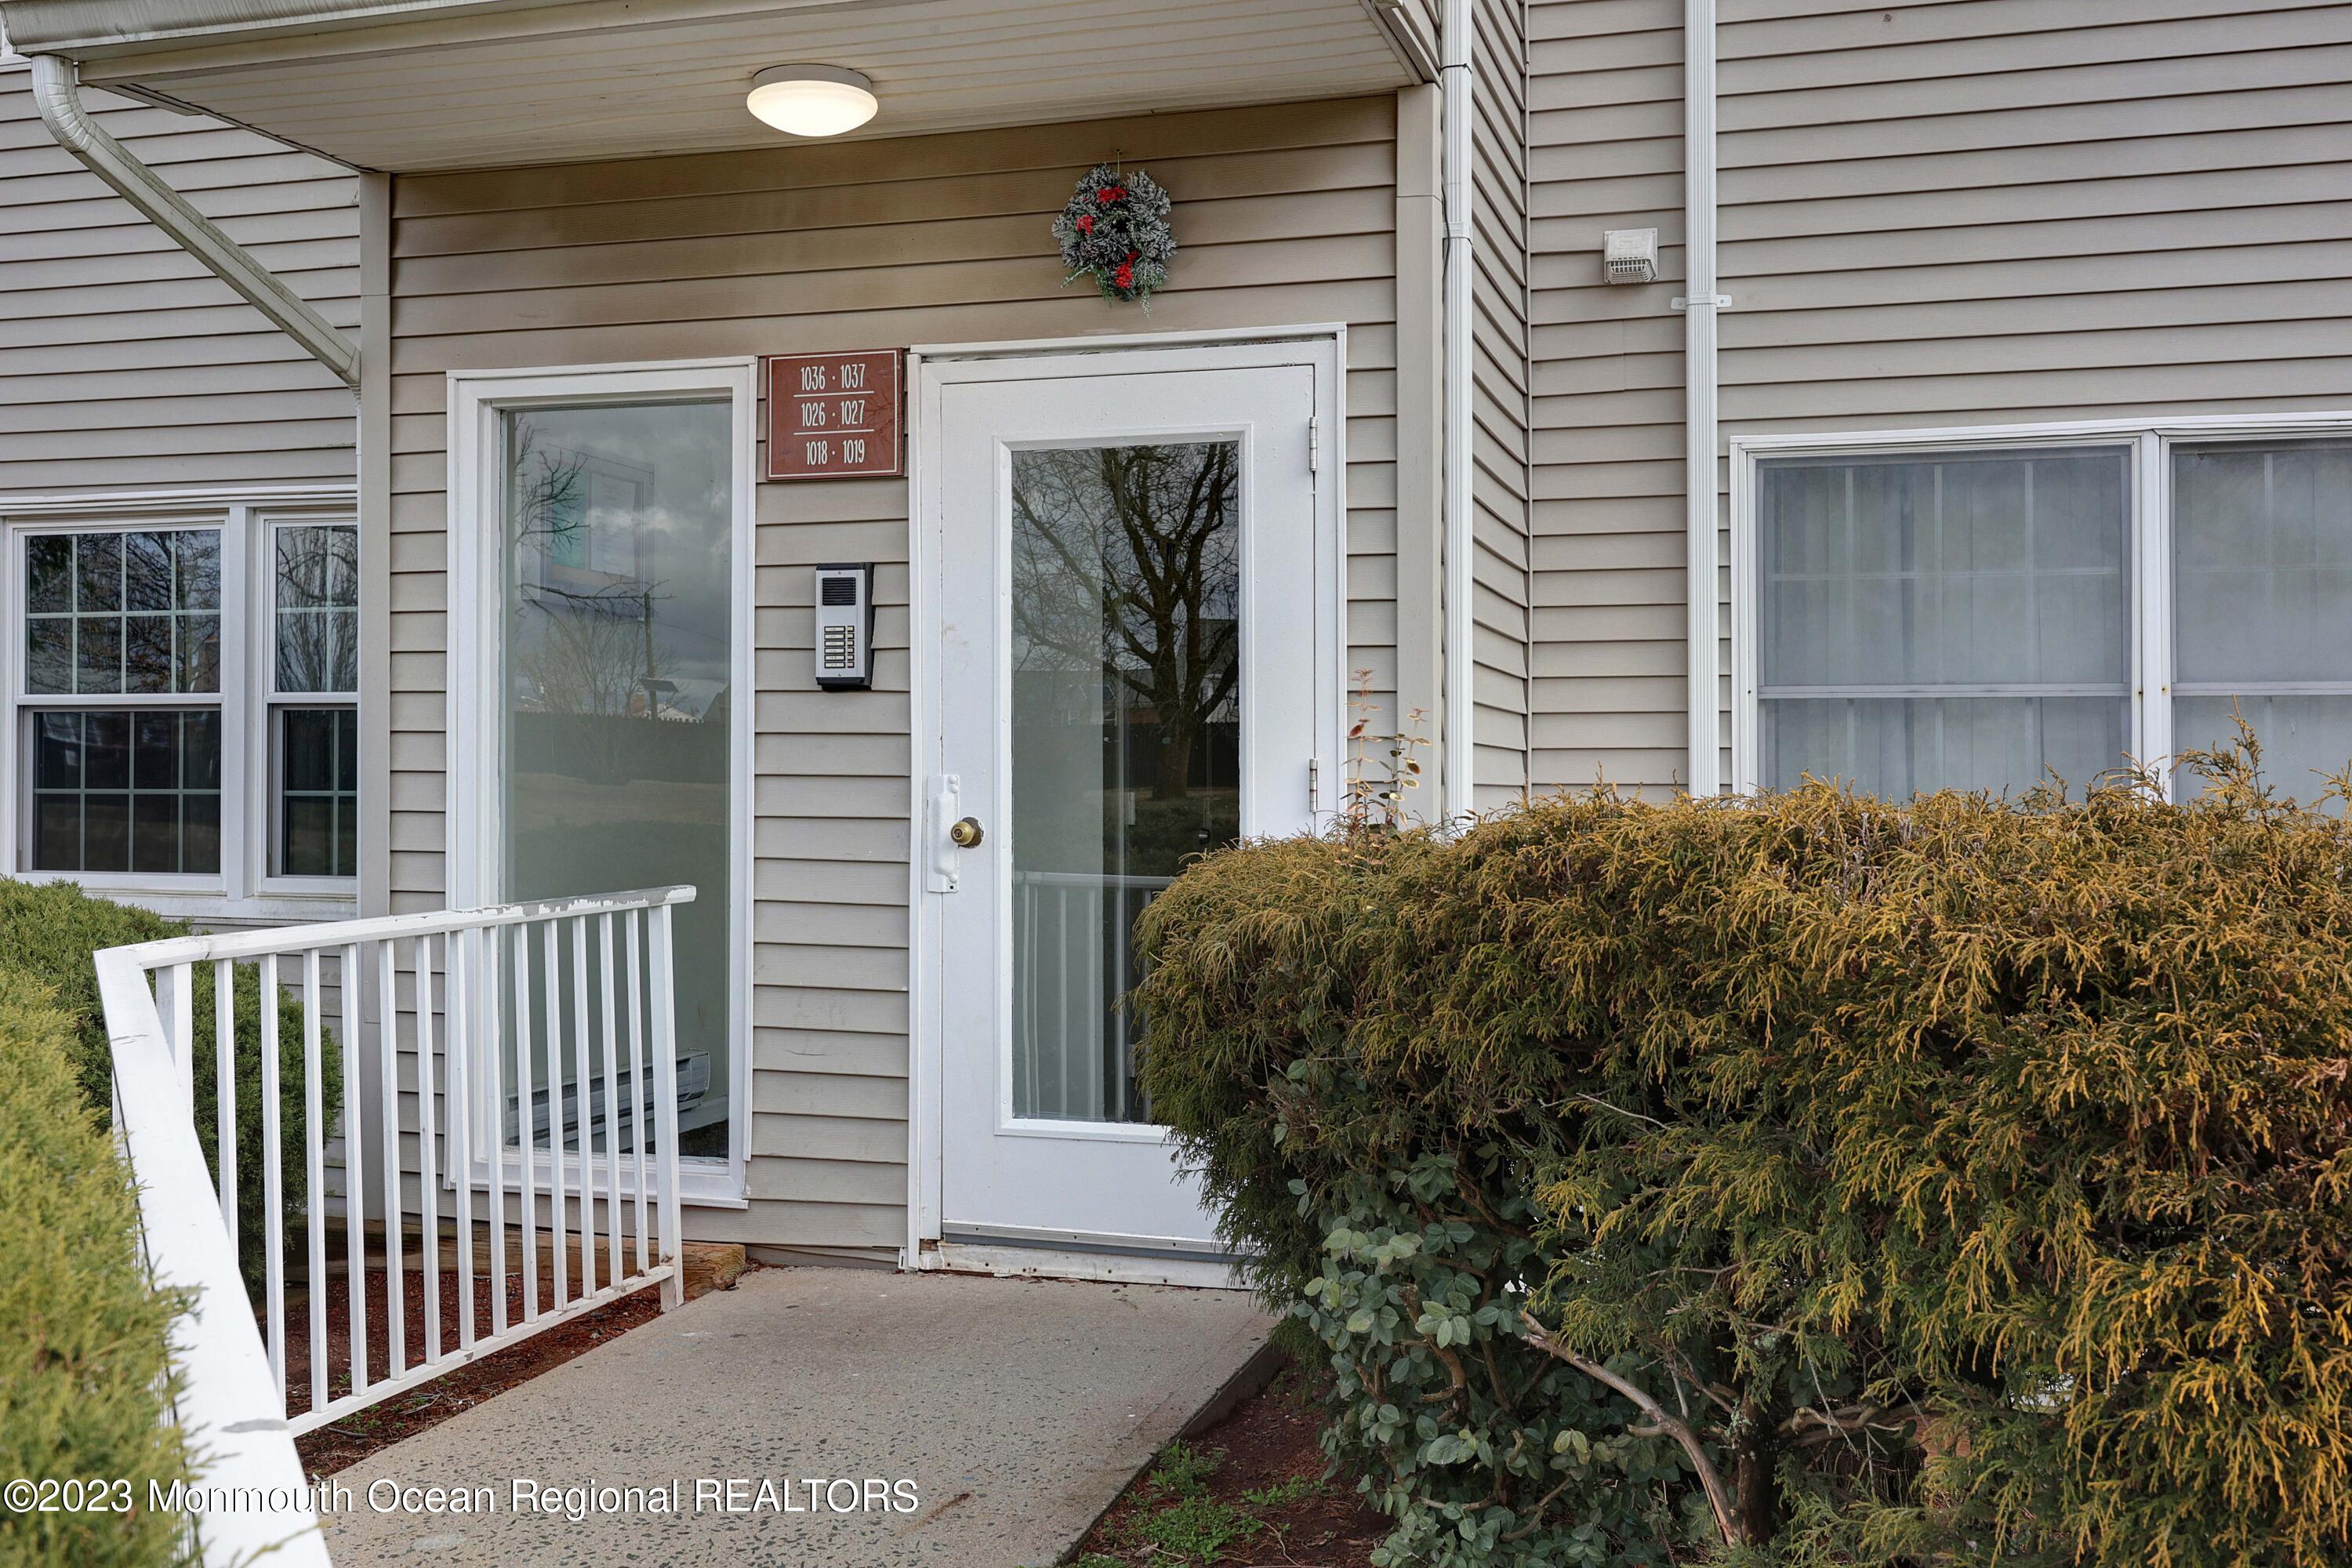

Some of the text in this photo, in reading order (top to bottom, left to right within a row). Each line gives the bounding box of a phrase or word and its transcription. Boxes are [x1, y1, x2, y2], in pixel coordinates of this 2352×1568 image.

[800, 364, 866, 390] 1036 1037
[801, 400, 866, 426] 1026 1027
[806, 439, 866, 466] 1018 1019
